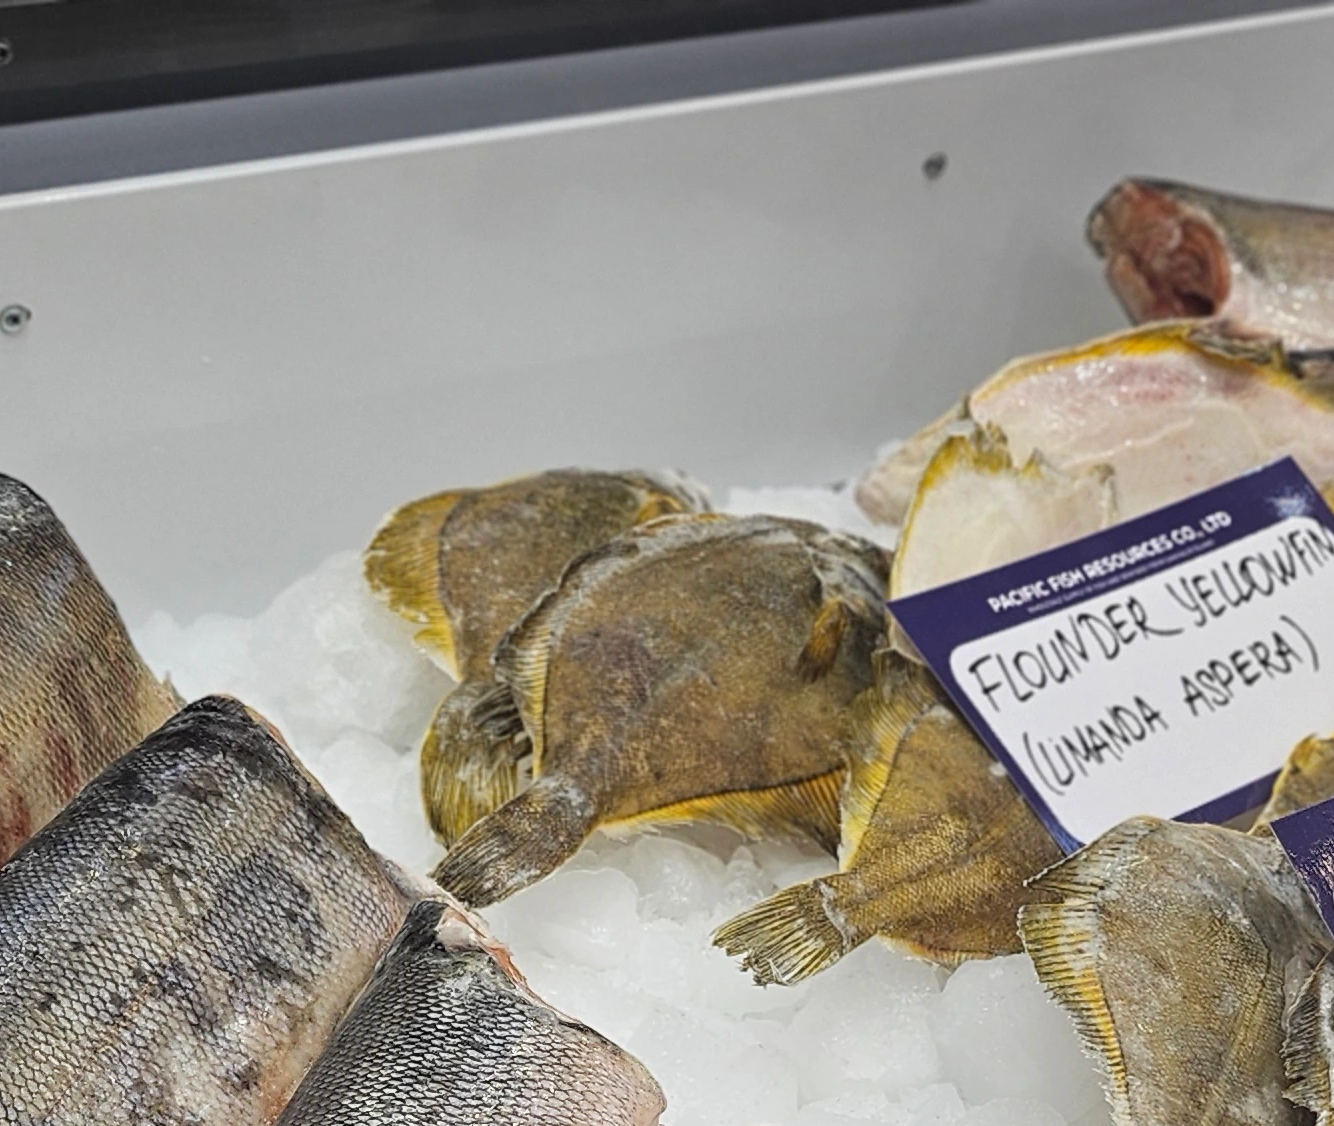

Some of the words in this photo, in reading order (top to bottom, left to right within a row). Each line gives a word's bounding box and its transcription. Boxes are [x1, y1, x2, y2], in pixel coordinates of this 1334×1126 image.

[987, 580, 1050, 613] PACIFIC
[1047, 568, 1085, 592] FISH
[1083, 534, 1174, 580] RESOURCES
[1200, 511, 1233, 533] LTD
[968, 596, 1184, 713] FLOUNDER
[1180, 615, 1320, 716] ASPERA)
